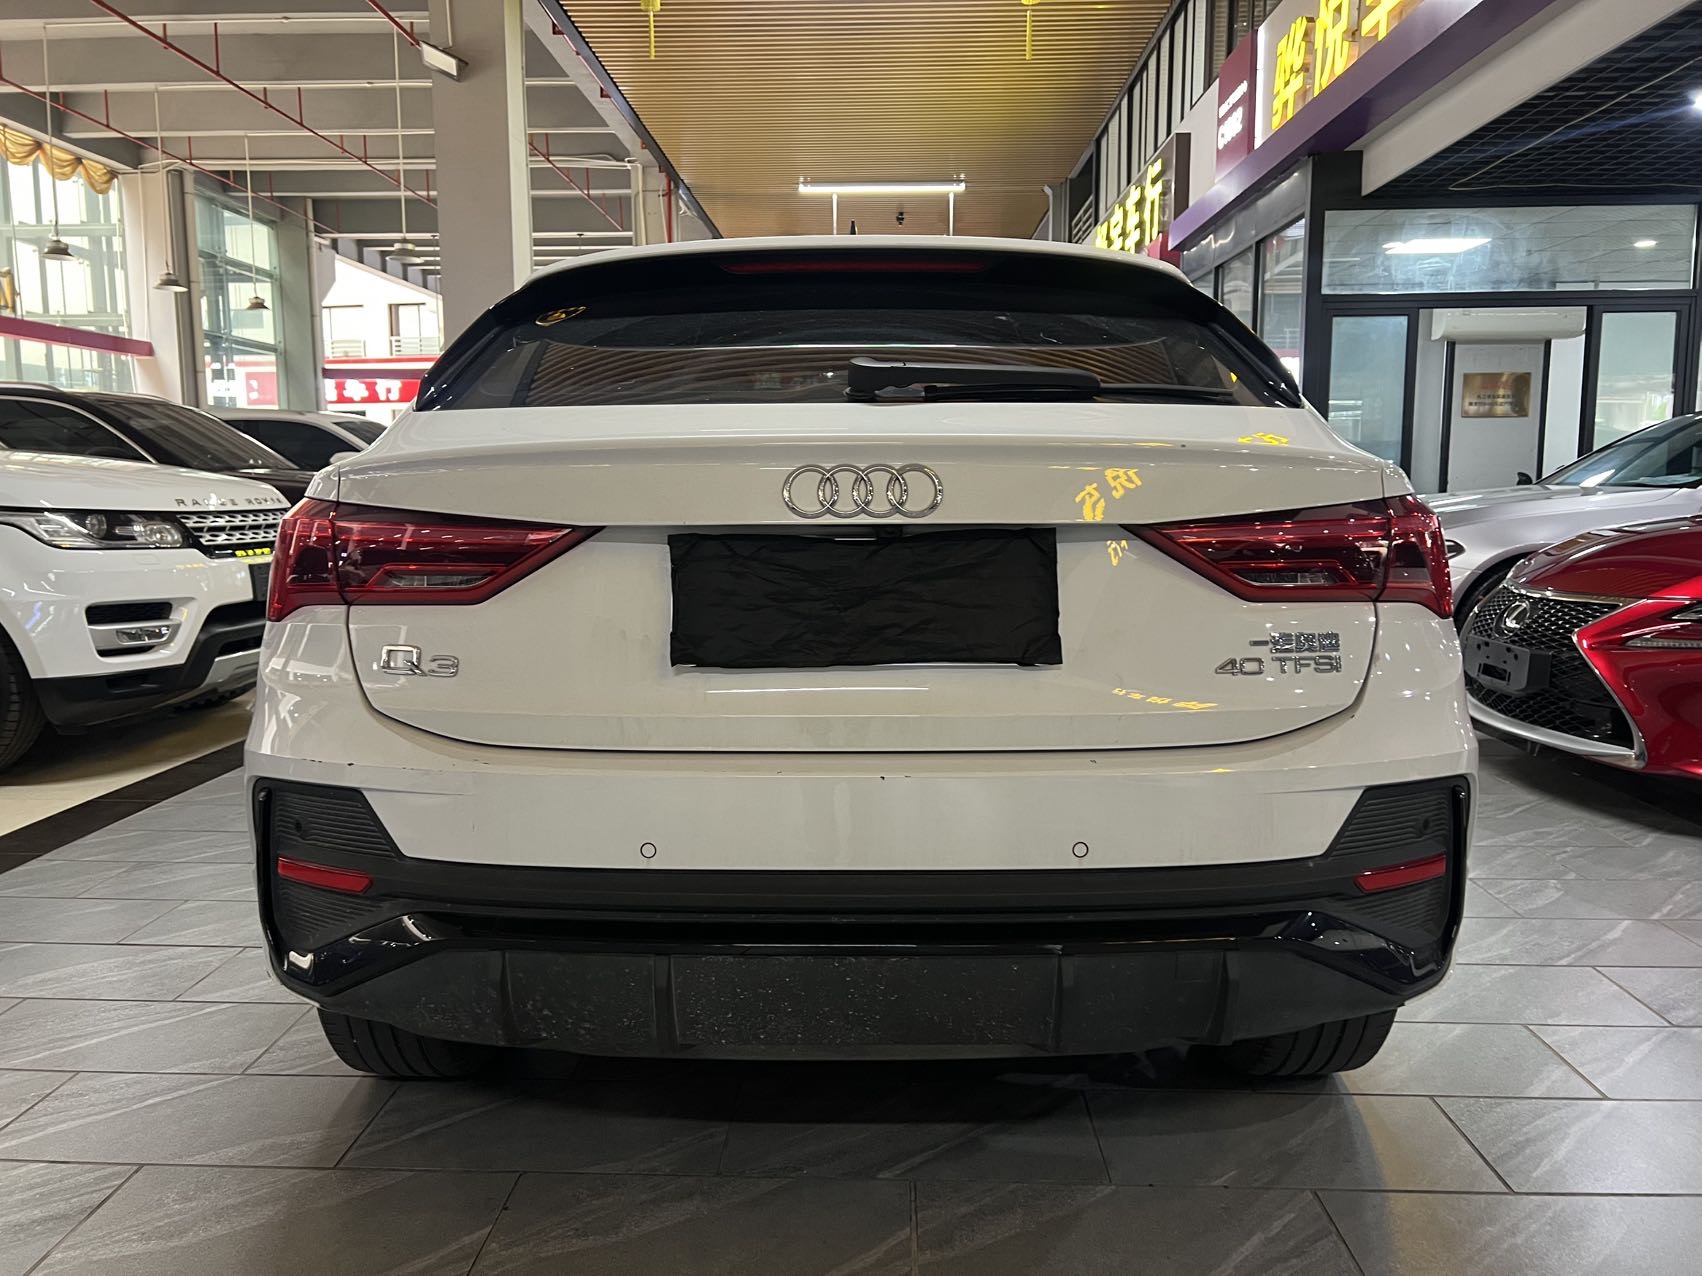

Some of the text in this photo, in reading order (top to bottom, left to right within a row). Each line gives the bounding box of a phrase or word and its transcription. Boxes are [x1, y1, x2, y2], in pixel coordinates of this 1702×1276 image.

[380, 644, 460, 678] Q3
[1214, 655, 1342, 676] 40 TFSI
